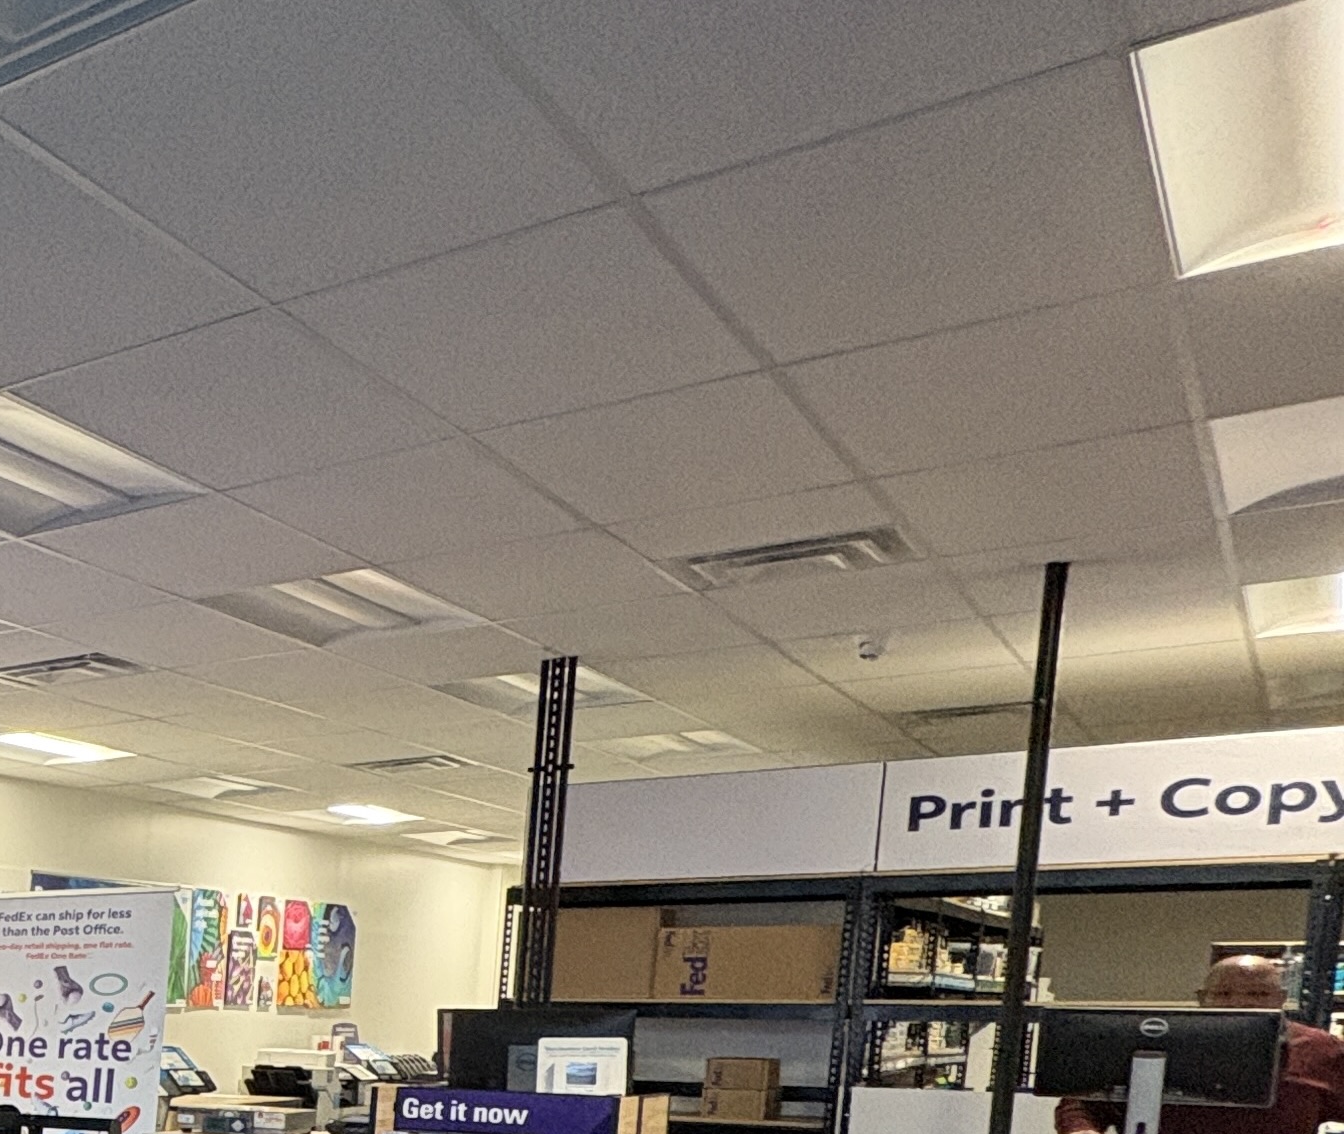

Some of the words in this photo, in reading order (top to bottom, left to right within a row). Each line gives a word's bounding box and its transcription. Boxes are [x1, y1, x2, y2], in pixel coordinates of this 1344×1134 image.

[1160, 777, 1344, 826] Copy
[2, 926, 29, 937] than
[31, 925, 50, 937] the
[53, 925, 80, 936] Post
[83, 923, 124, 935] Office.
[35, 911, 56, 922] can
[58, 909, 84, 923] ship
[87, 908, 104, 920] for
[107, 908, 132, 920] less
[58, 1032, 133, 1062] rate
[65, 1067, 115, 1103] all
[402, 1097, 445, 1121] Get
[449, 1099, 468, 1122] it
[473, 1106, 529, 1125] now
